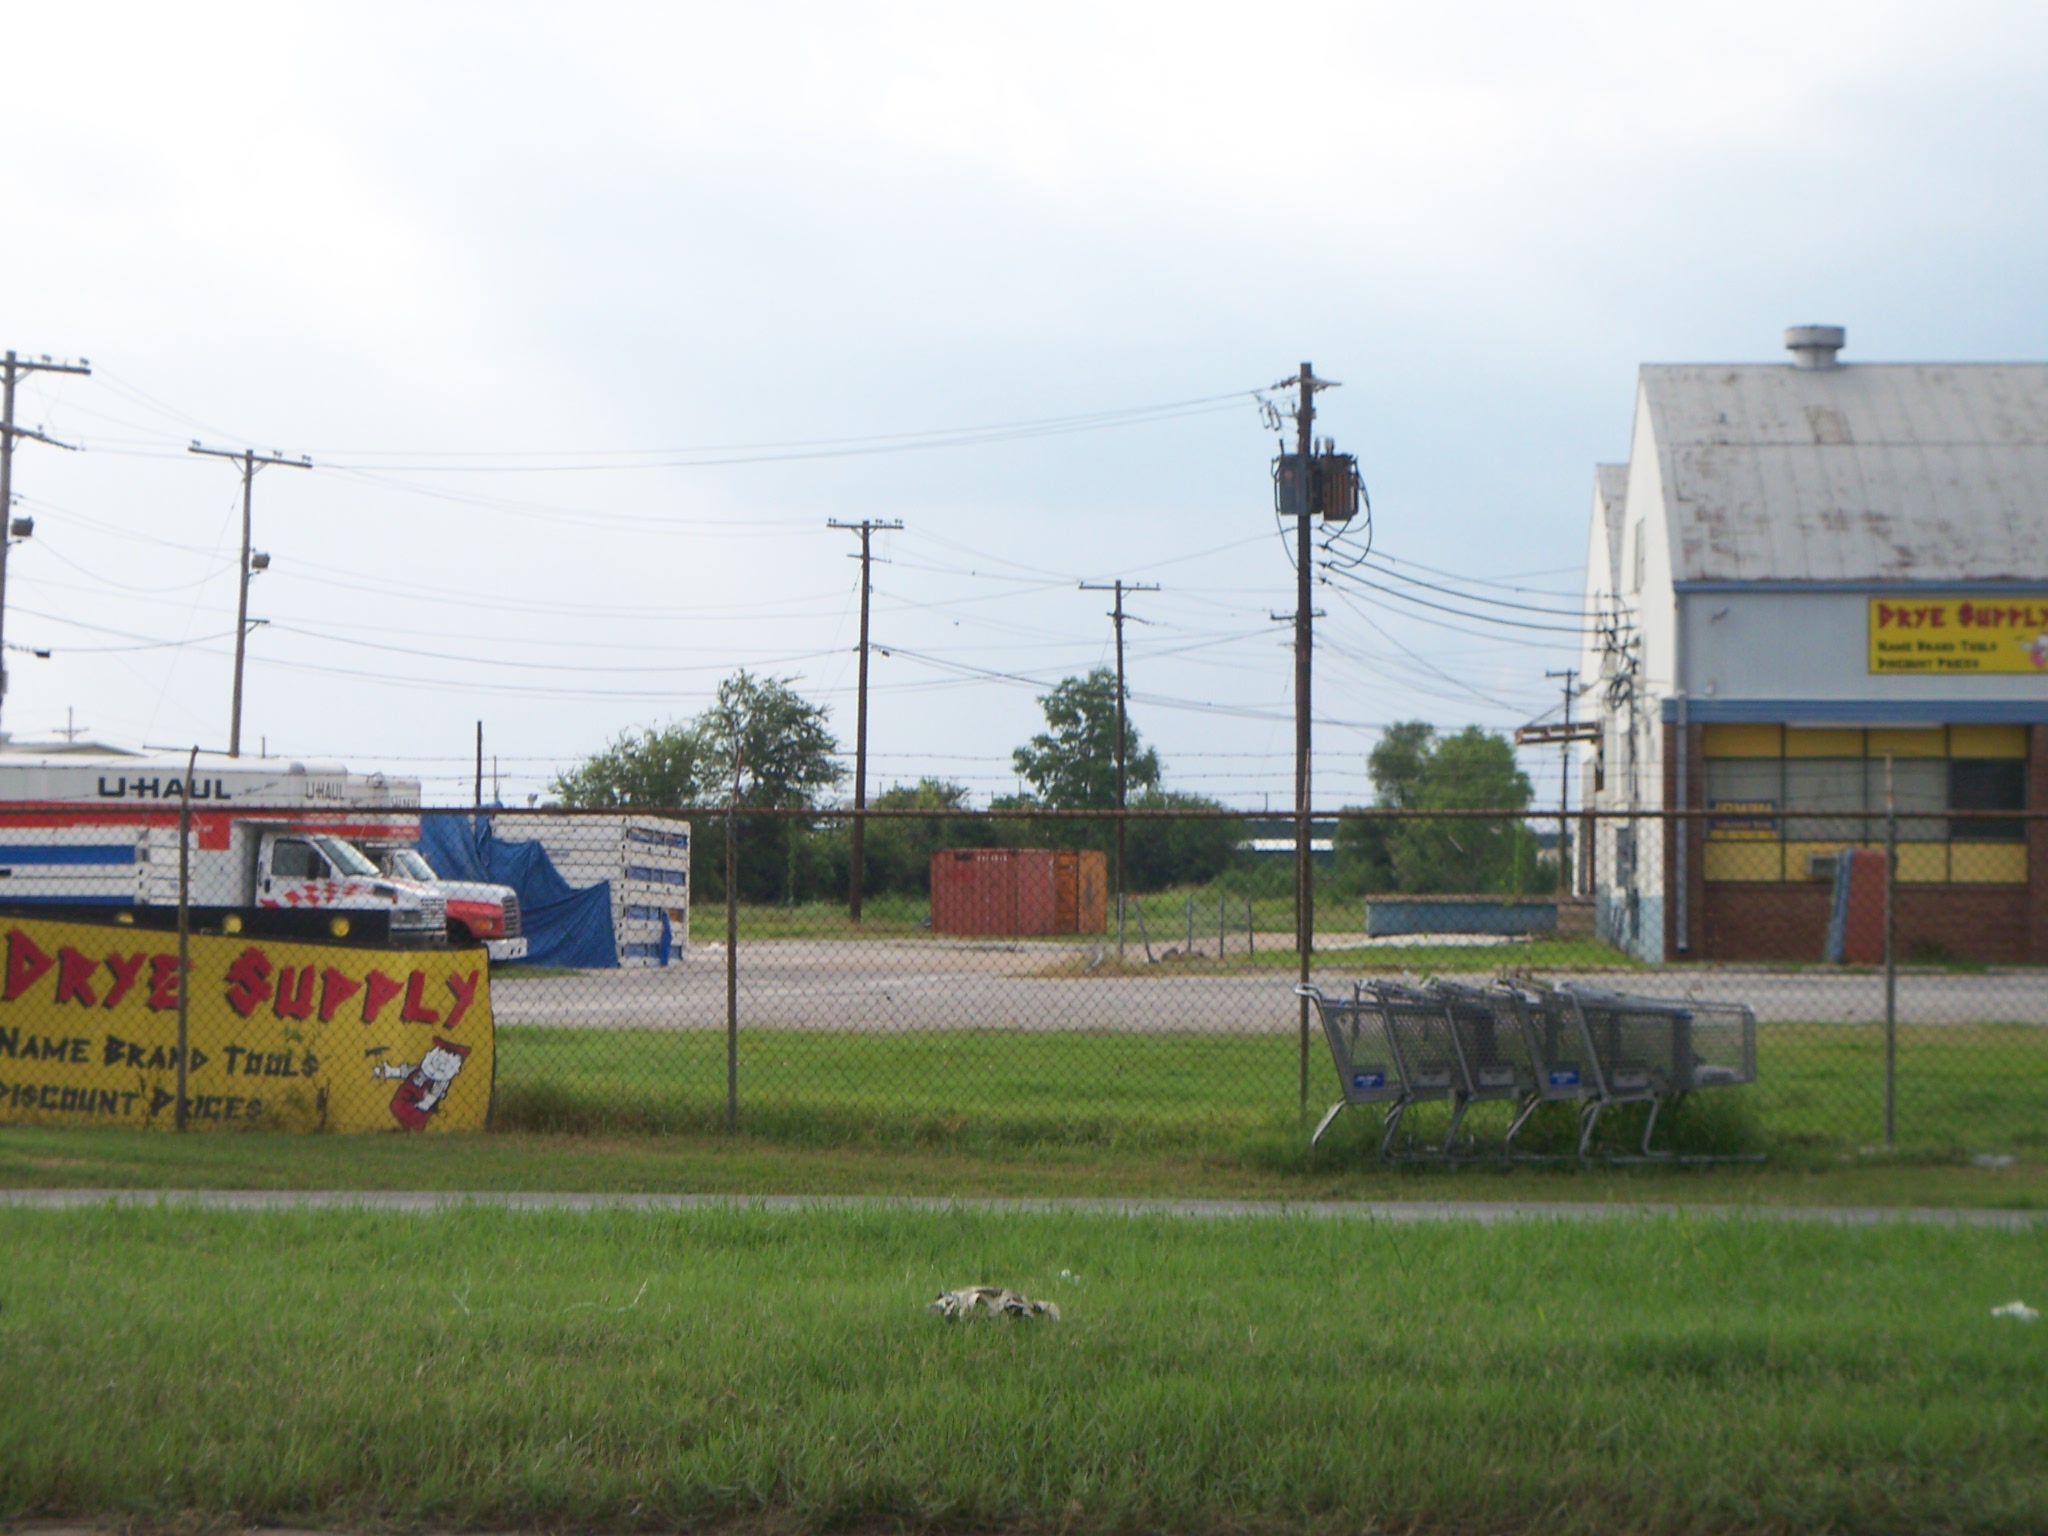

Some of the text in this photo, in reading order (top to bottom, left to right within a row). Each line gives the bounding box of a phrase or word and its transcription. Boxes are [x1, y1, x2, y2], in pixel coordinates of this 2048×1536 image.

[1878, 602, 1945, 630] DRYE
[97, 775, 231, 799] U-HAUL
[305, 781, 345, 801] U-HAUL
[2, 927, 481, 1028] DRYE SUPPLY
[0, 1026, 319, 1077] NAME BRAND TOOLS
